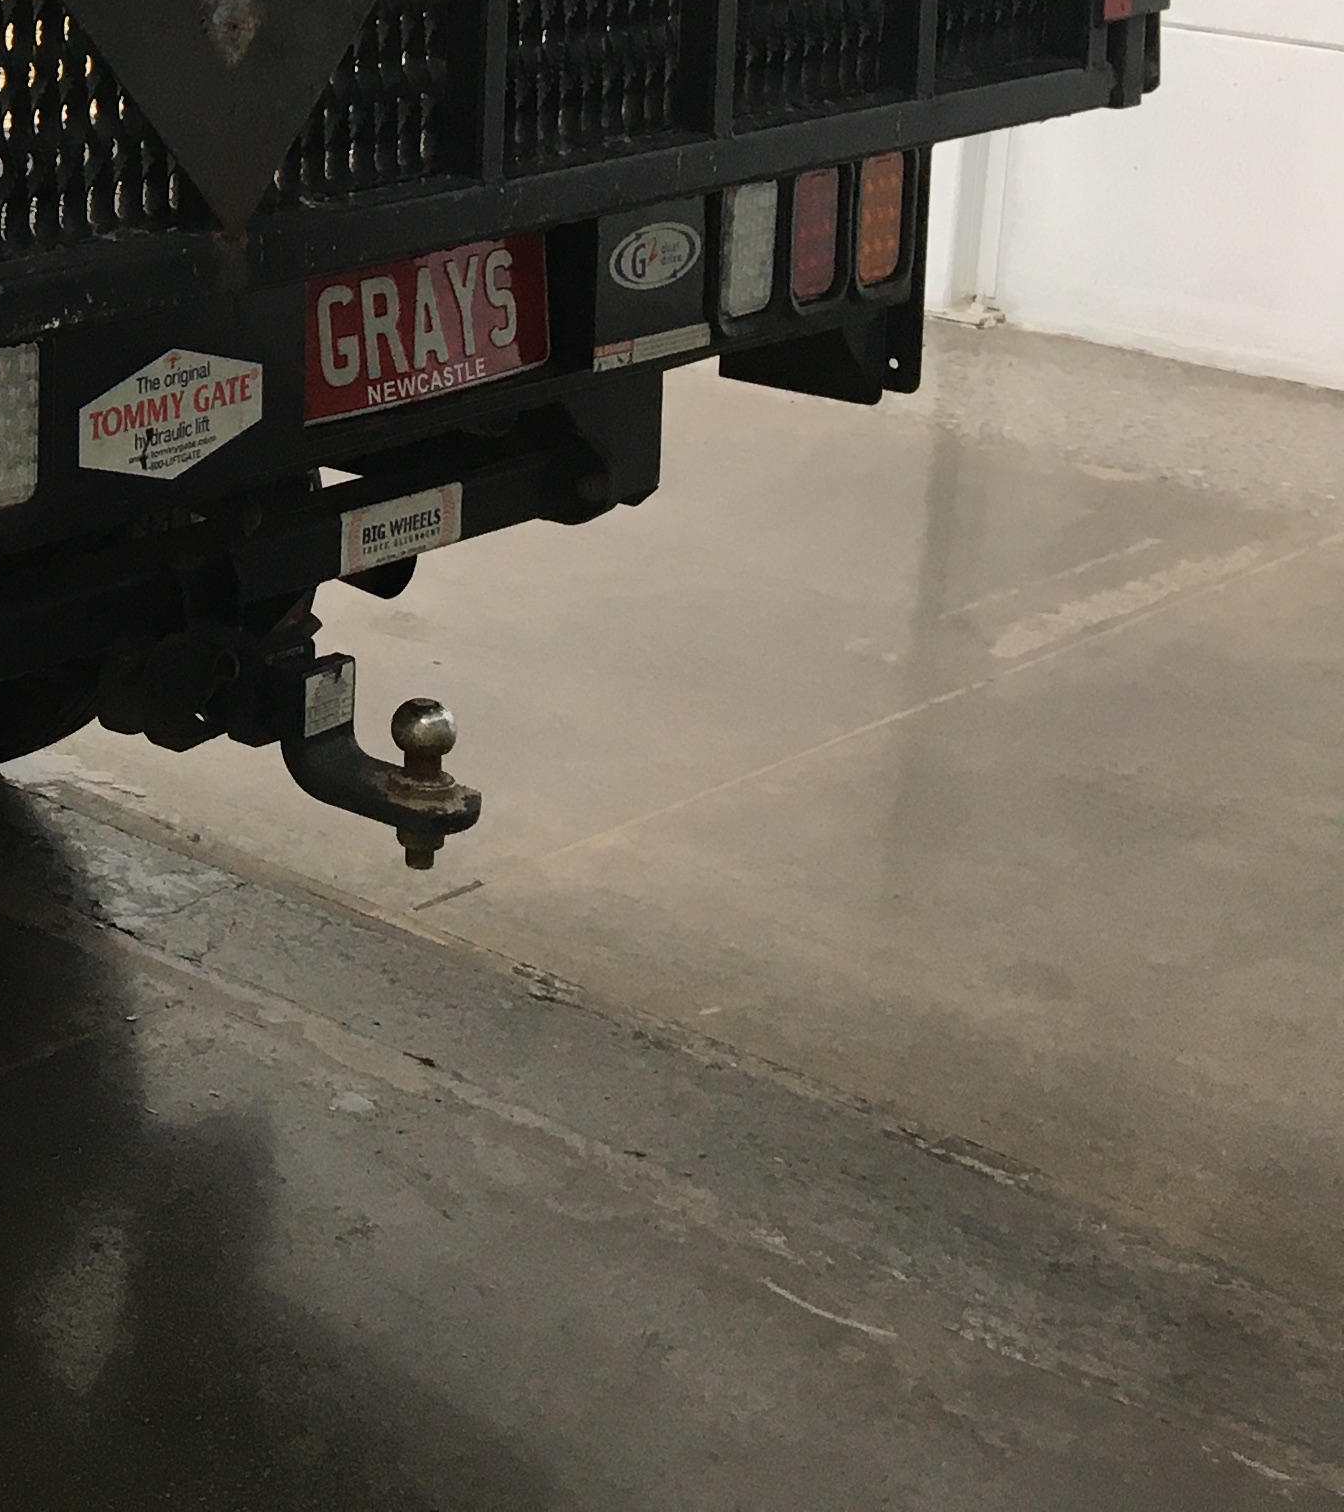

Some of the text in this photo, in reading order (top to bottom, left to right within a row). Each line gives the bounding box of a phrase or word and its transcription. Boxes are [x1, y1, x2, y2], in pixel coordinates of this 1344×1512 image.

[316, 248, 518, 388] GRAYS
[136, 361, 211, 394] The original
[367, 357, 486, 406] NEWCASTLE
[88, 390, 184, 441] TOMMY
[134, 415, 210, 451] hydraulic lift
[362, 508, 441, 545] BIG WHEELS
[363, 540, 390, 555] TRUCK
[393, 526, 441, 548] ALIGNMENT
